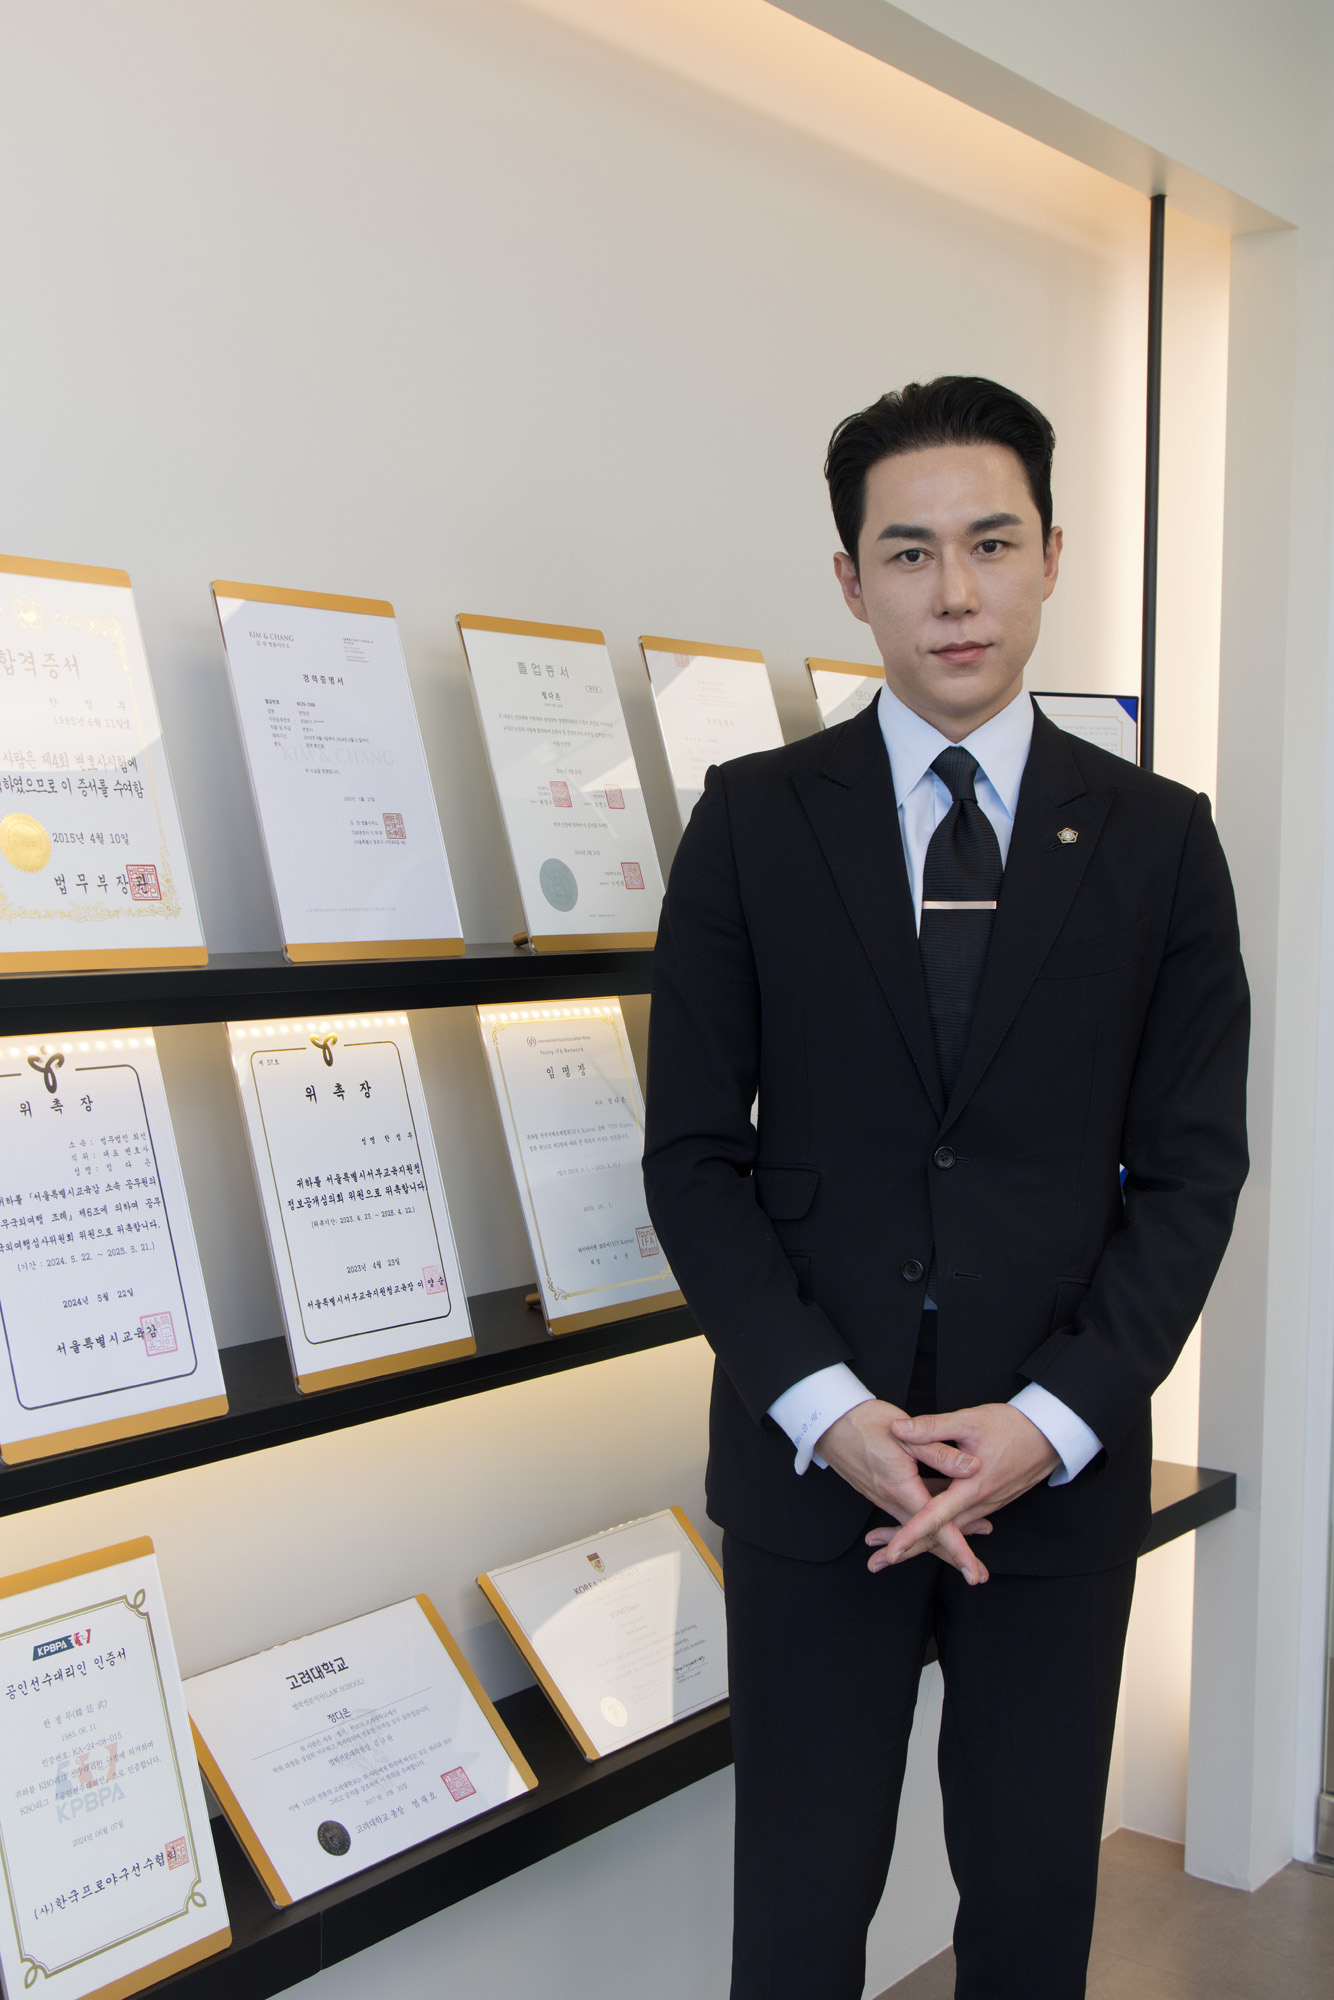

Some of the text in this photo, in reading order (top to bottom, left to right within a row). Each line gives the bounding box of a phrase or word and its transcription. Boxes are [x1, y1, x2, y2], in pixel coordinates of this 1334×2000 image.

[248, 631, 262, 639] KIM
[269, 633, 294, 642] CHANG
[42, 751, 69, 771] 제4회
[0, 774, 144, 799] 하였으므로 이 증서를 수여함
[52, 832, 129, 845] 2015년 4월 10일
[105, 1181, 121, 1193] 소속
[125, 1175, 156, 1190] 공무원의
[297, 1175, 322, 1190] 귀하를
[79, 1204, 108, 1219] 제6조에
[115, 1199, 139, 1213] 의하여
[145, 1197, 161, 1209] 공무
[287, 1190, 344, 1212] 정보공개심의회
[348, 1186, 382, 1202] 위원으로
[79, 1226, 113, 1241] 위원으로
[117, 1219, 161, 1235] 위촉합니다.
[47, 1256, 68, 1268] 2024.
[107, 1247, 128, 1258] 2025.
[346, 1257, 401, 1274] 2023년 4월 23일
[63, 1288, 134, 1309] 2024년 5월 22일
[56, 1324, 158, 1356] 서울특별시교육감
[37, 1640, 68, 1657] KPBPA
[5, 1647, 127, 1700] 공인선수대리인 인증서
[286, 1657, 349, 1690] 고려대학교
[327, 1707, 351, 1724] 정다은
[56, 1783, 126, 1824] KPBPA
